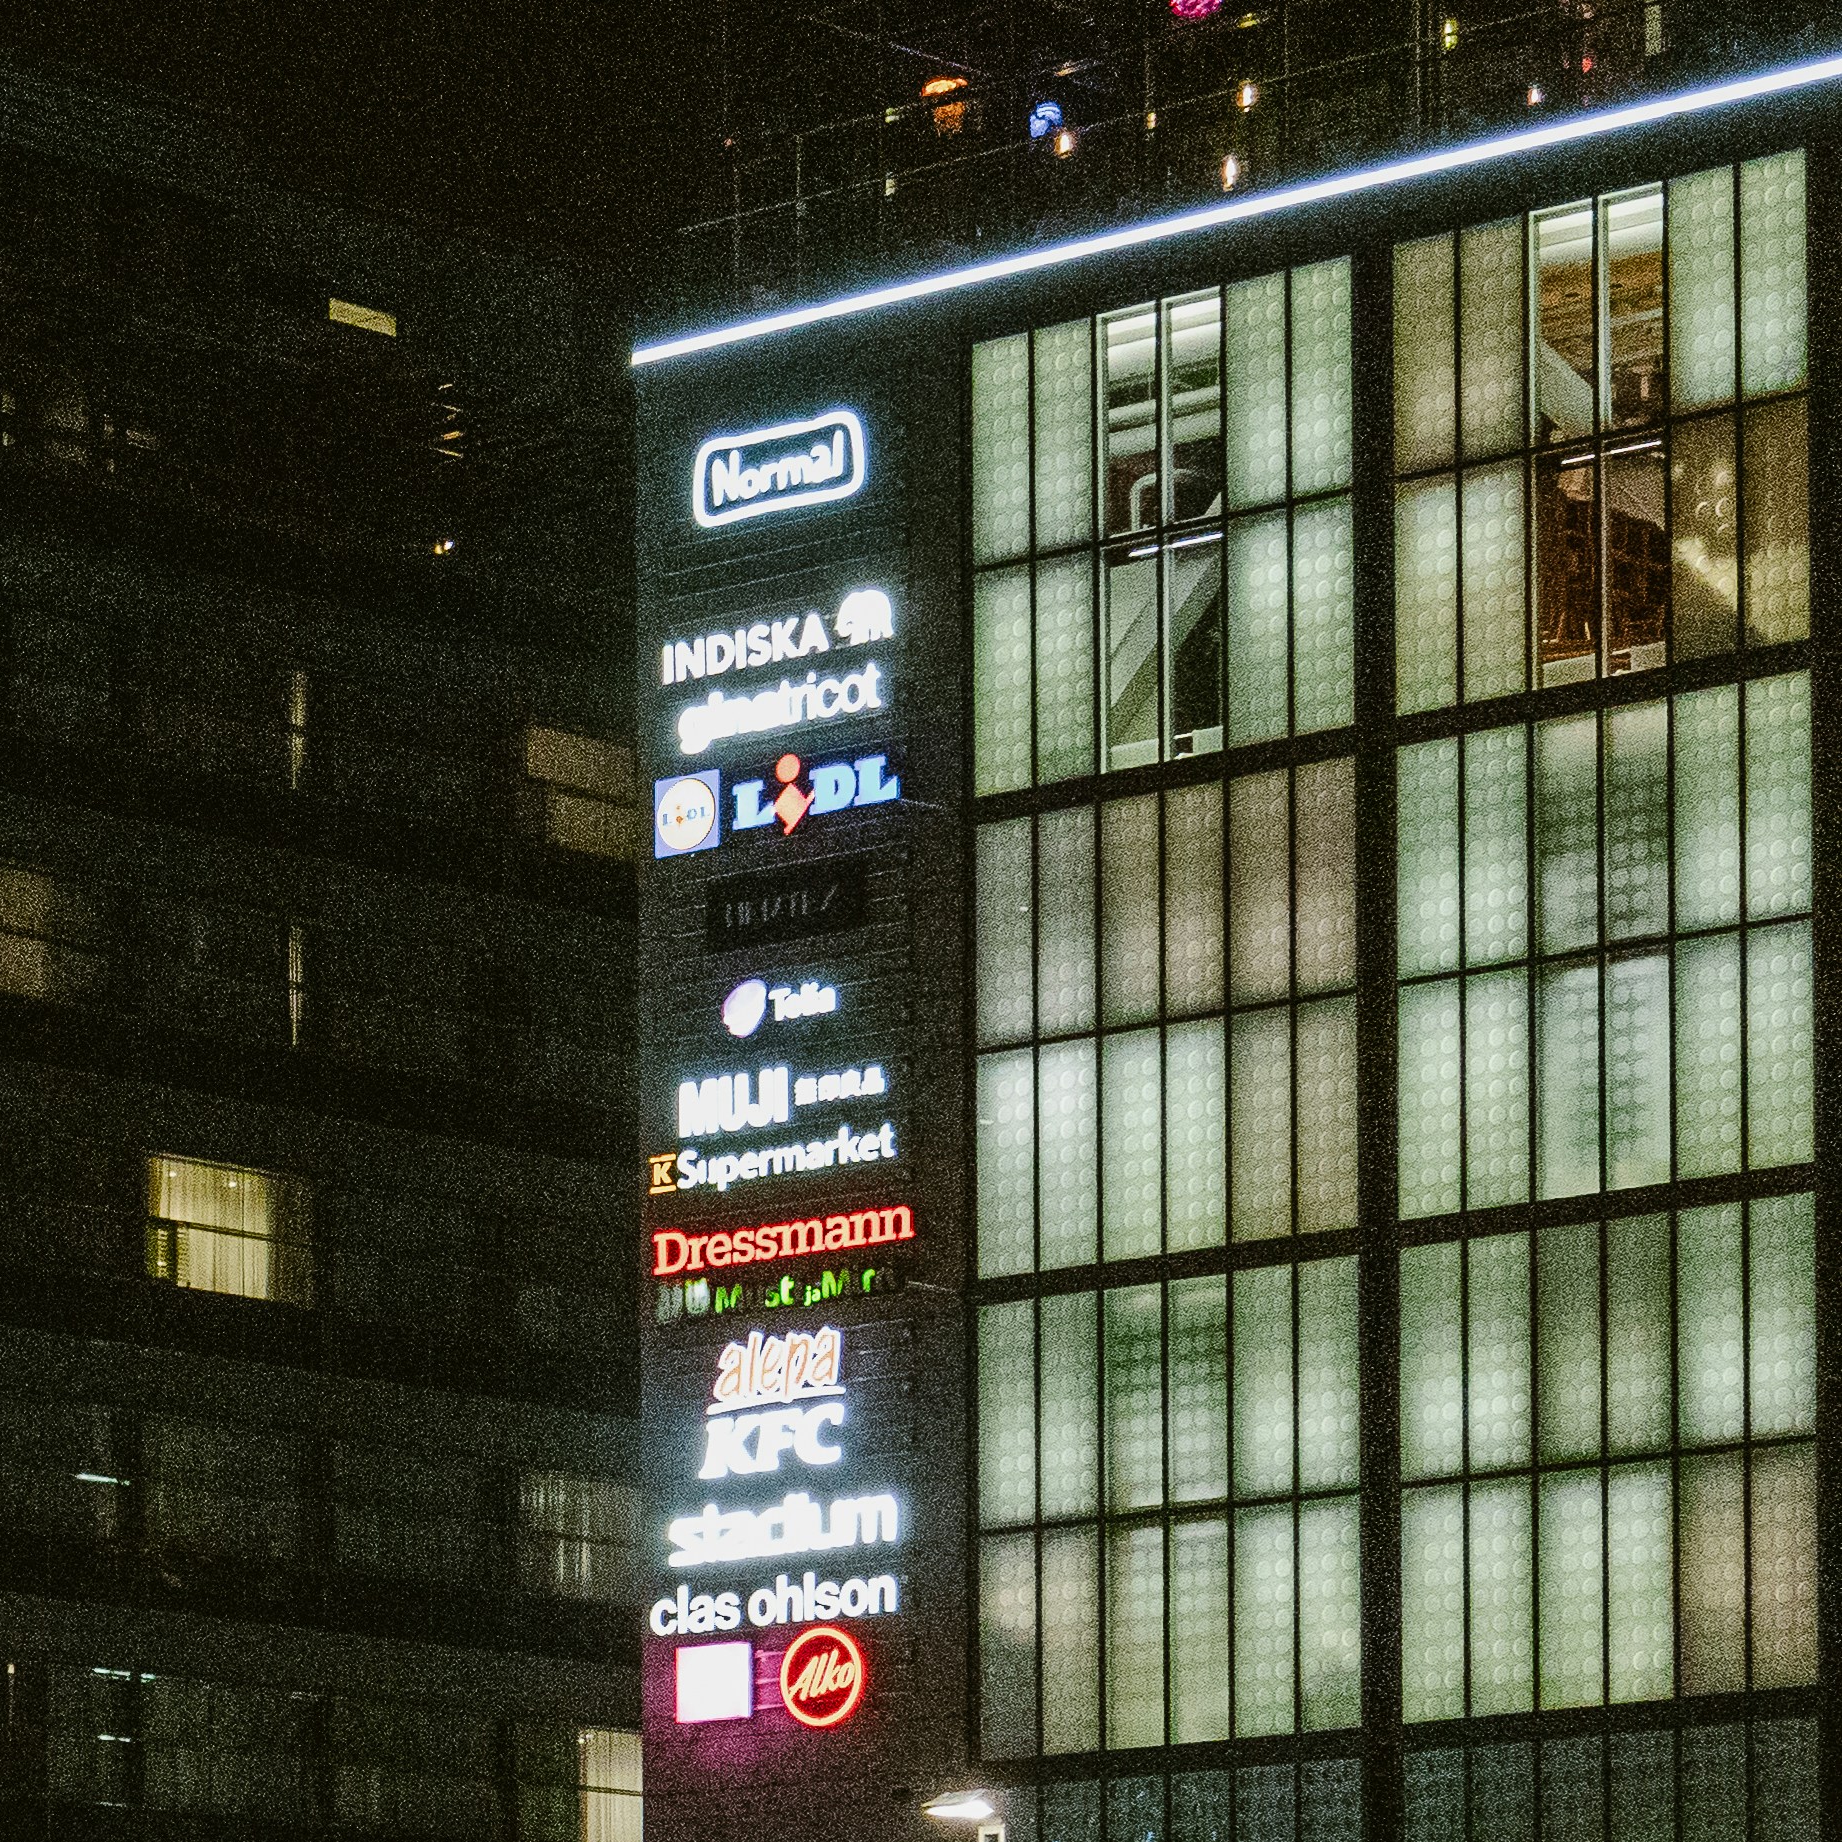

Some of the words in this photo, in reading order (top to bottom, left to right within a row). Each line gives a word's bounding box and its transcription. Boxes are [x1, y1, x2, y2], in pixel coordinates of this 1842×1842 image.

[711, 428, 845, 508] Normal
[662, 613, 830, 686] INDISKA
[678, 1066, 790, 1139] MUJI
[677, 1123, 897, 1192] Supermarket
[652, 1204, 916, 1277] Dressmann
[713, 1326, 844, 1403] alepa
[697, 1402, 845, 1480] KFC
[668, 1492, 899, 1568] stadium
[649, 1584, 741, 1637] clas
[747, 1571, 898, 1627] ohlson
[787, 1648, 857, 1702] Alko
